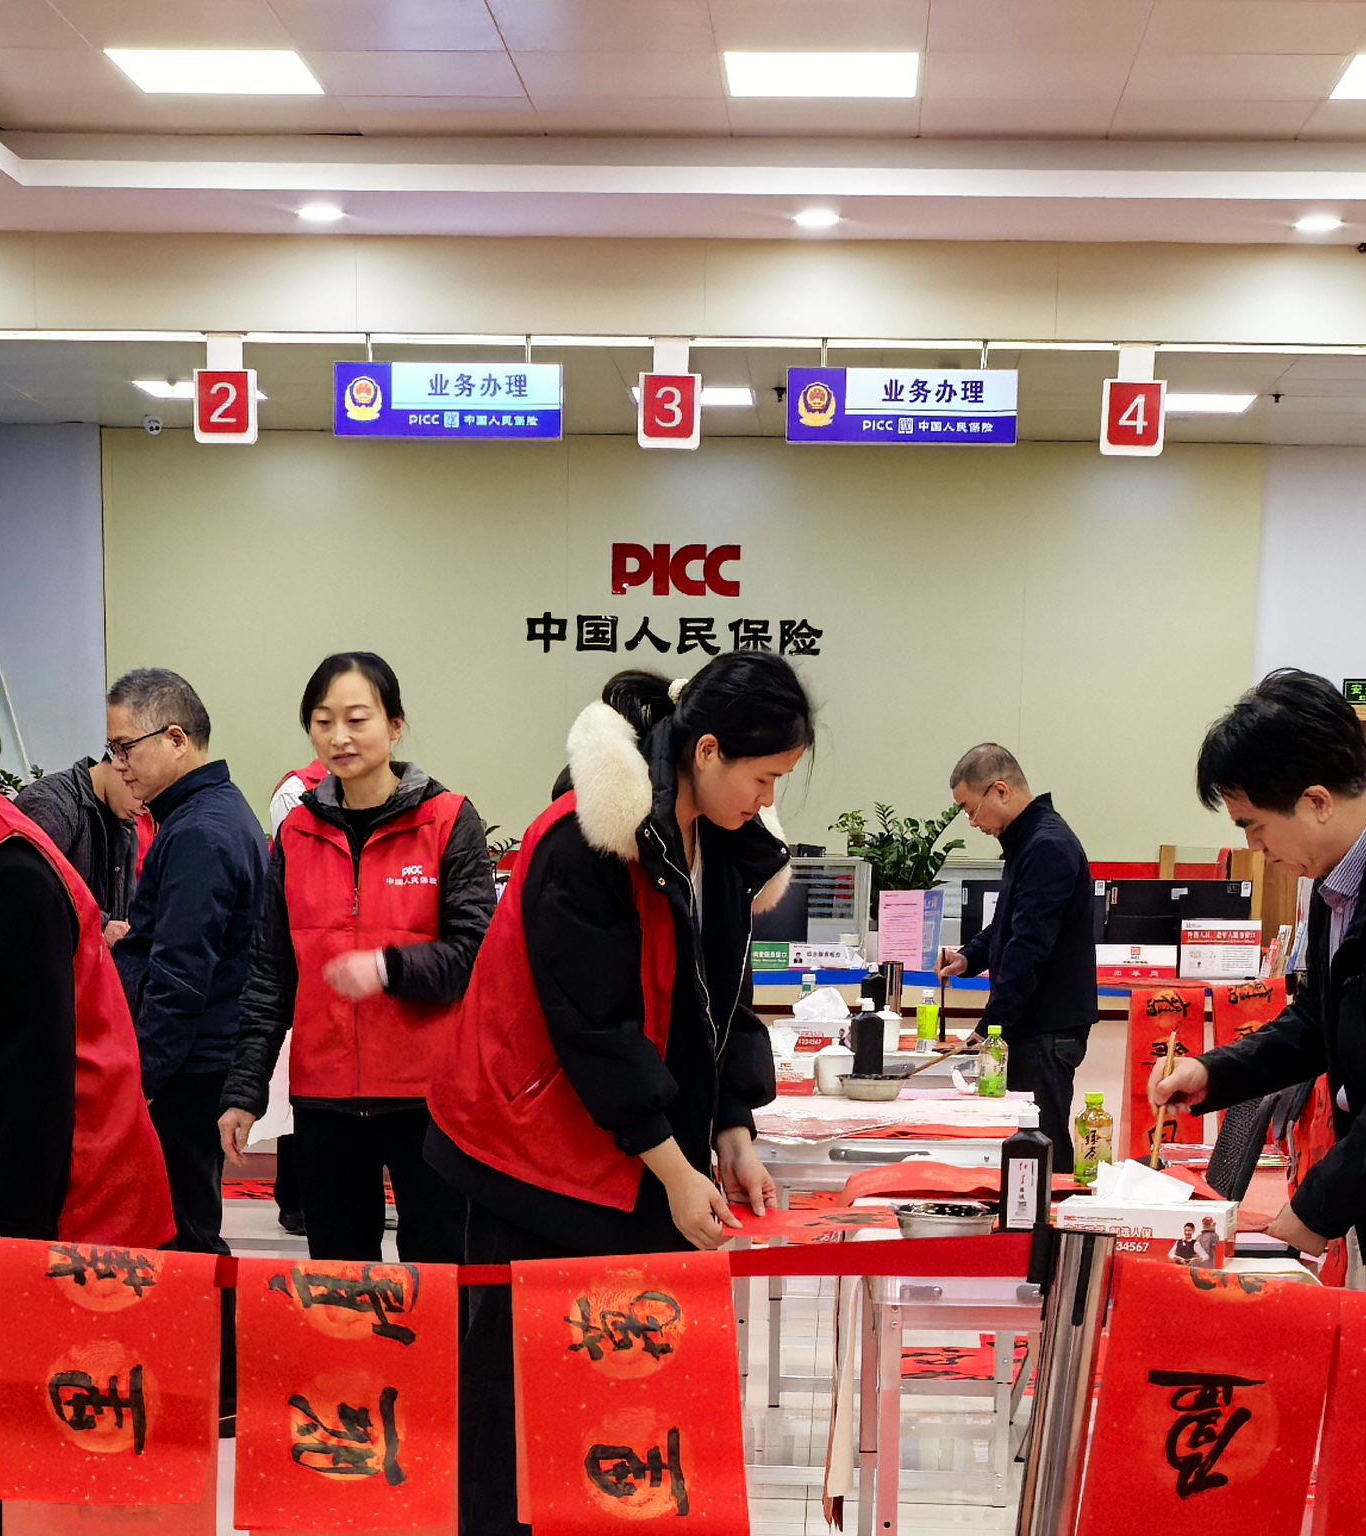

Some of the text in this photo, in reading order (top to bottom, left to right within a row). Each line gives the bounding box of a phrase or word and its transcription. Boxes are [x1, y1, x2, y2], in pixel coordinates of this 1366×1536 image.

[209, 381, 238, 424] 2
[427, 372, 529, 399] 业务办理
[881, 378, 985, 404] 业务办理
[408, 413, 538, 427] PICC 中国人民保险
[653, 385, 684, 429] 3
[1117, 392, 1149, 435] 4
[861, 419, 994, 434] PICC 中国人民保险
[610, 542, 742, 597] PICC
[524, 610, 824, 658] 中国人民保险
[401, 864, 424, 876] PICC
